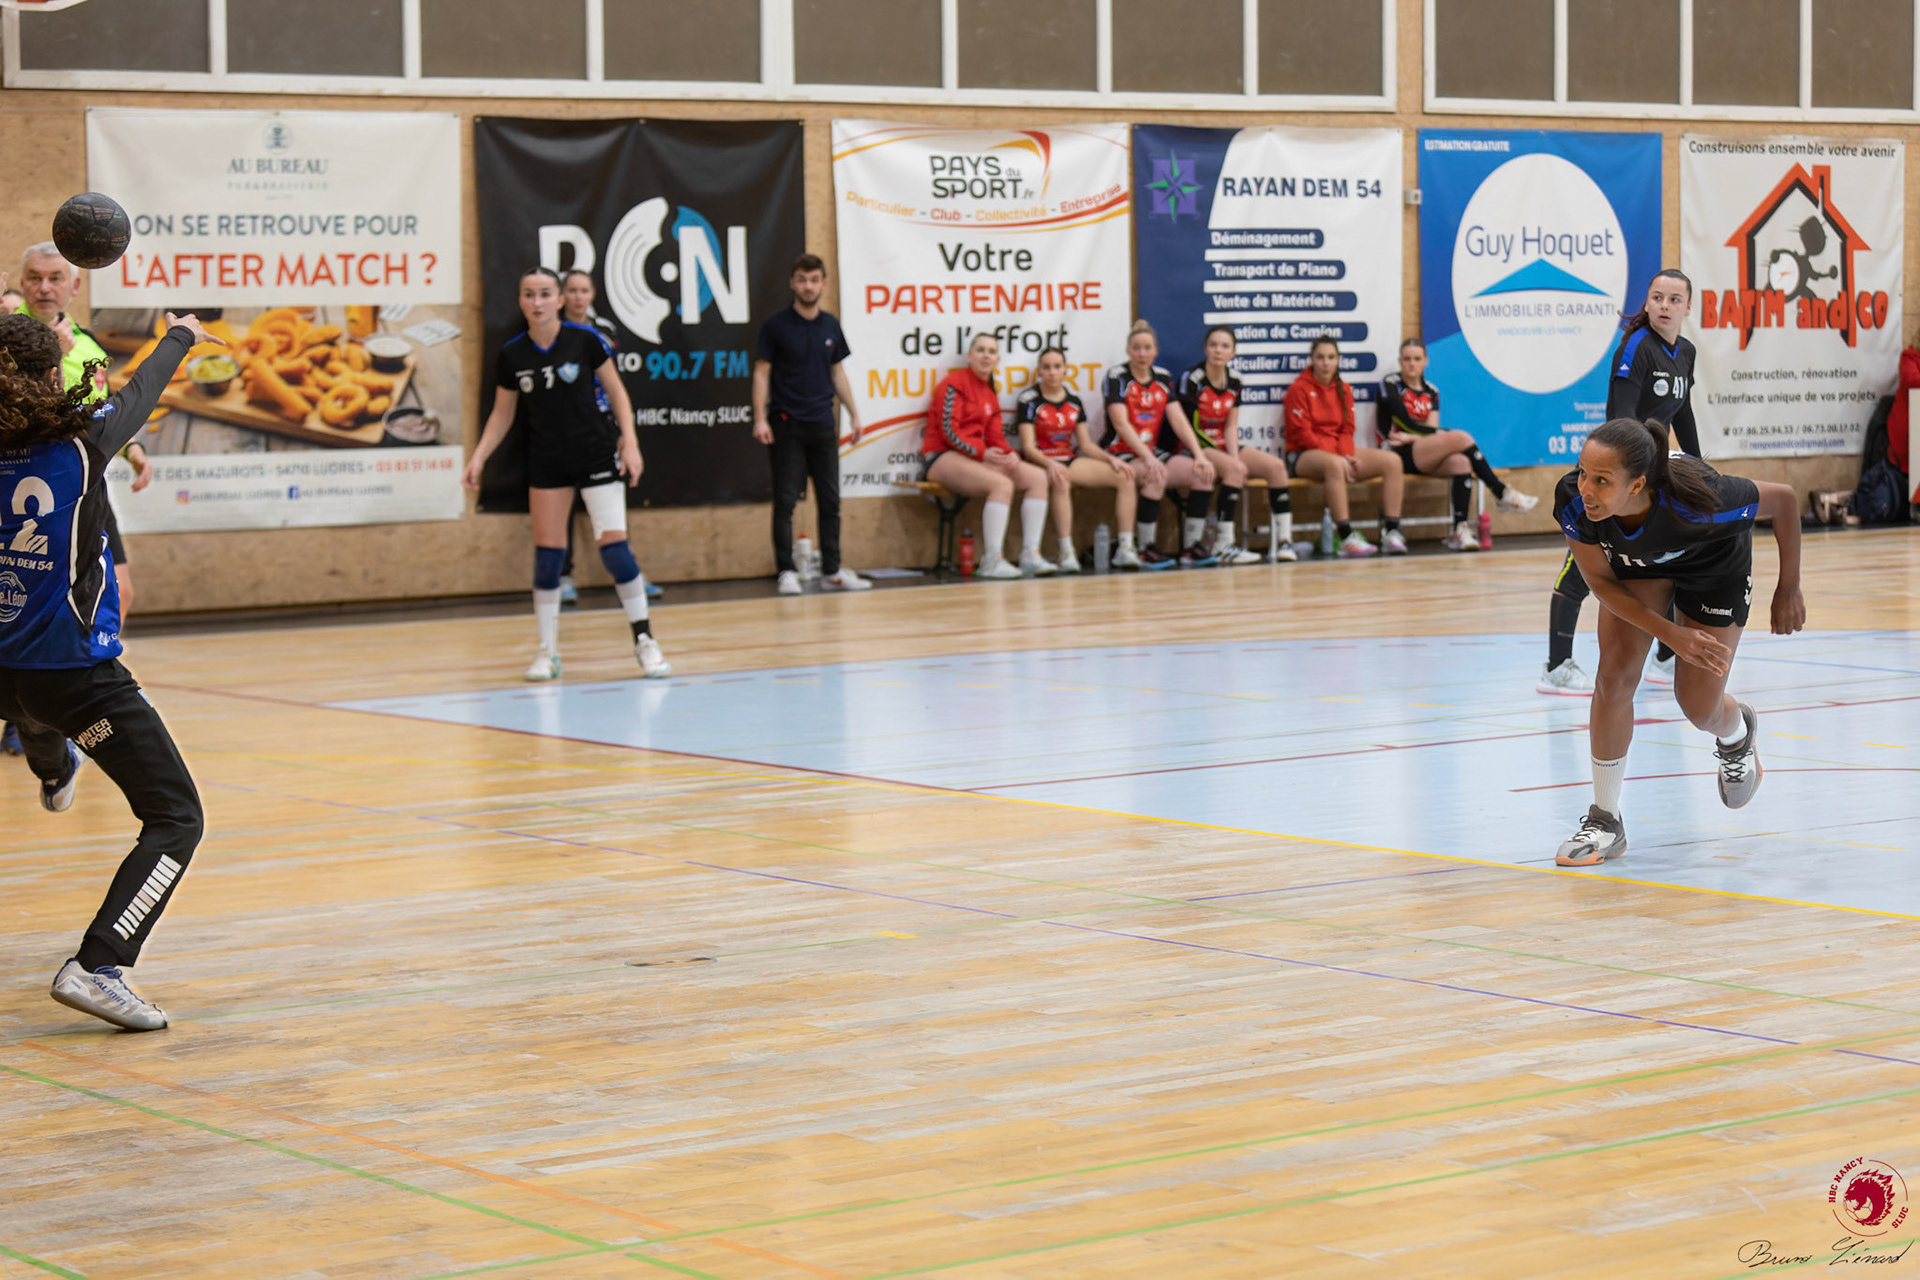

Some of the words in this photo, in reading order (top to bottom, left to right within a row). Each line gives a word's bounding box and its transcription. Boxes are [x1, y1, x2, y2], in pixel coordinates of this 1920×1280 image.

[1689, 140, 1766, 155] Construisons
[1768, 141, 1824, 156] ensemble
[1828, 145, 1858, 156] votre
[1860, 145, 1896, 158] avenir
[256, 158, 331, 175] BUREAU
[930, 156, 1001, 176] PAYS
[1223, 176, 1296, 198] RAYAN
[1303, 178, 1348, 198] DEM
[1356, 179, 1382, 198] 54
[846, 190, 916, 216] Particulier
[930, 207, 962, 222] Club
[975, 203, 1047, 222] Collectivité
[1060, 182, 1122, 214] Entreprise
[134, 214, 174, 236] ON
[182, 214, 209, 236] SE
[218, 214, 346, 236] RETROUVE
[354, 214, 418, 236] POUR
[1211, 230, 1316, 248] Déménagement
[1465, 225, 1515, 264] Guy
[1522, 226, 1615, 262] Hoquet
[938, 243, 1033, 272] Votre
[276, 252, 409, 287] MATCH
[420, 252, 438, 286] ?
[1212, 262, 1275, 279] Transport
[1278, 263, 1295, 277] de
[1298, 262, 1338, 277] Piano
[865, 282, 1102, 315] PARTENAIRE
[1212, 294, 1250, 309] Vente
[1252, 294, 1269, 308] de
[1271, 292, 1336, 308] Matériels
[1701, 288, 1785, 330] BATIM
[1796, 290, 1849, 330] and
[1856, 289, 1889, 330] CO
[901, 326, 943, 355] de
[957, 323, 1069, 355] l'ffort
[1270, 325, 1288, 340] de
[1290, 324, 1342, 340] Camion
[646, 351, 707, 381] 90.7
[713, 350, 750, 379] FM
[1731, 368, 1798, 381] Construction,
[1801, 367, 1858, 380] rénovation
[1767, 392, 1801, 405] unique
[1804, 391, 1817, 402] de
[1820, 392, 1836, 402] vos
[1838, 389, 1876, 403] projets
[637, 407, 669, 426] HBC
[670, 406, 716, 428] Nancy
[717, 405, 752, 424] SLUC
[1548, 435, 1567, 455] 03
[862, 471, 890, 485] RUE
[17, 557, 37, 570] DEM
[36, 560, 54, 572] 54
[1701, 603, 1733, 617] hummel
[87, 725, 114, 748] SPORT
